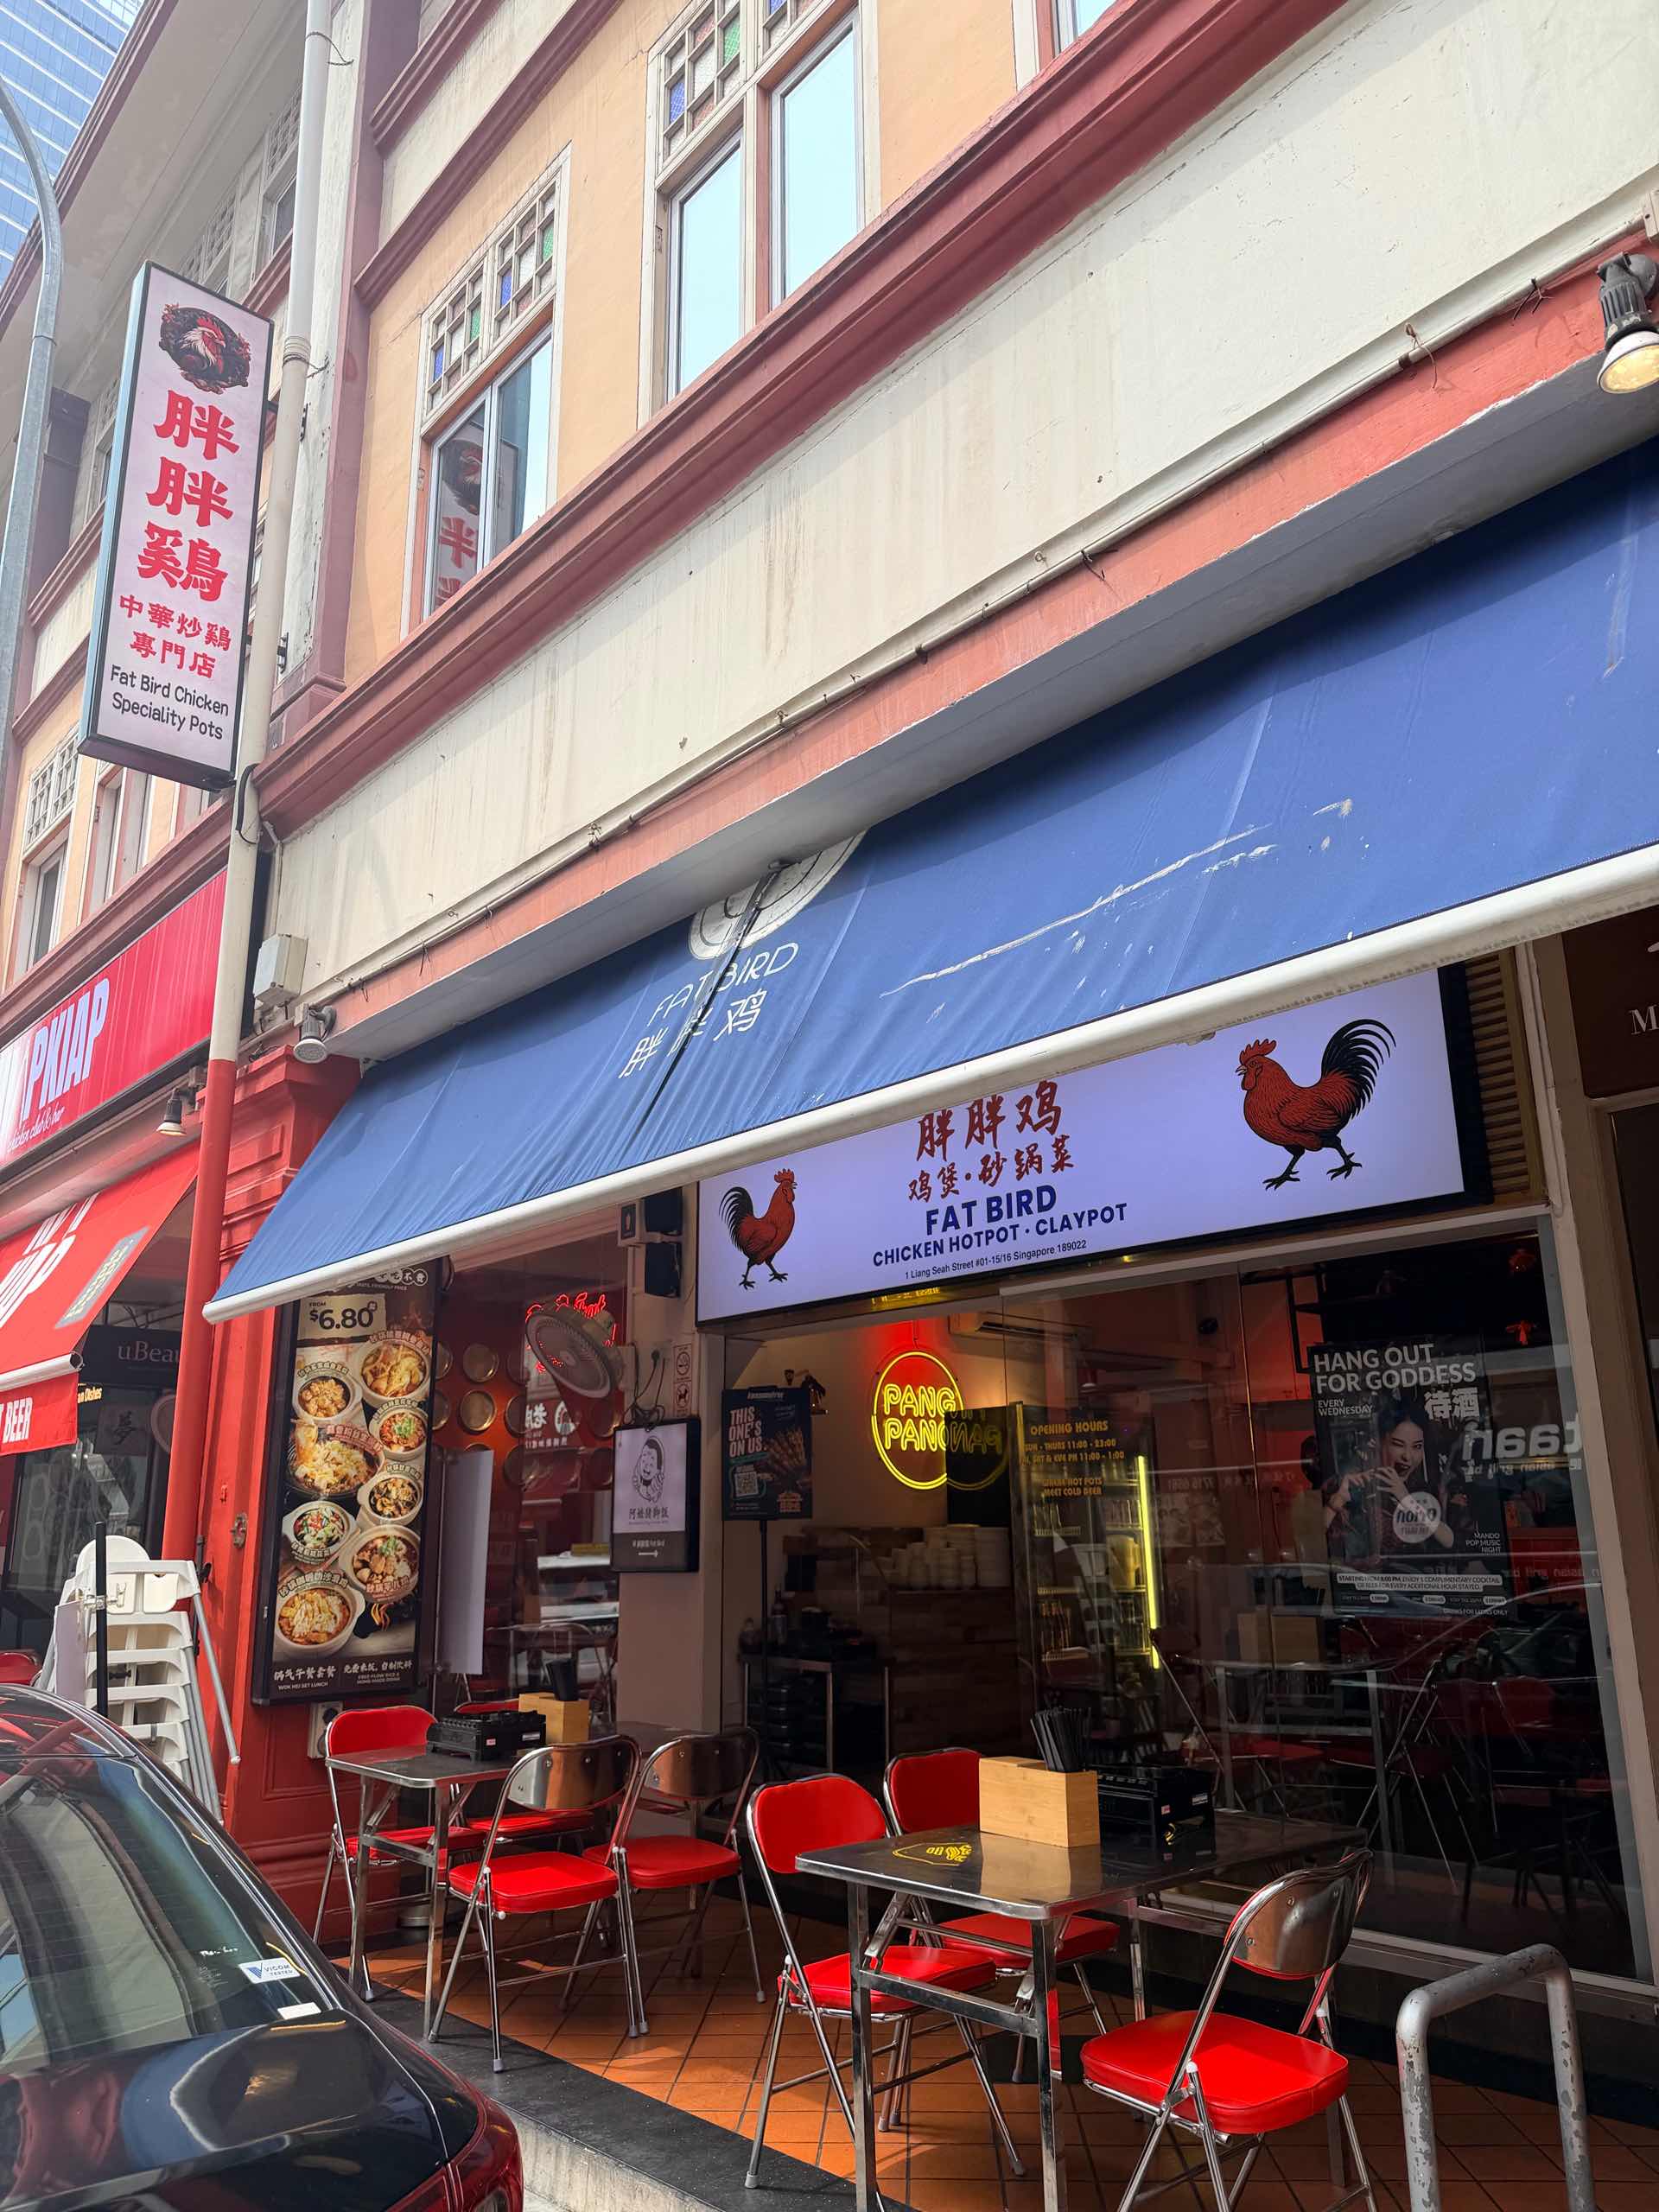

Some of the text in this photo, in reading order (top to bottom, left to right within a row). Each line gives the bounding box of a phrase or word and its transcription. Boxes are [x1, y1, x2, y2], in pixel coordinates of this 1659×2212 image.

[130, 630, 216, 677] 專門店
[111, 664, 229, 717] Fat Bird Chicken
[112, 692, 224, 740] Speciality Pots
[648, 942, 799, 1027] FAT BIRD
[917, 1079, 1063, 1162] 胖胖鸡
[925, 1184, 1057, 1236] FAT BIRD
[873, 1239, 944, 1267] CHICKEN
[949, 1224, 1020, 1252] HOTPOT
[1036, 1203, 1128, 1236] CLAYPOT
[910, 1266, 931, 1281] Liang
[931, 1263, 950, 1275] Seah
[951, 1259, 974, 1272] Street
[976, 1251, 1012, 1268] #01-15/16
[1013, 1244, 1055, 1263] Singapore
[1057, 1239, 1087, 1254] 189022
[1314, 1343, 1434, 1373] HANG OUT
[1316, 1362, 1477, 1395] FOR GODDESS
[883, 1382, 956, 1418] PANG
[1318, 1398, 1344, 1408] EVERY
[1319, 1405, 1373, 1417] WEDNESDAY
[3, 1396, 34, 1444] BEER
[729, 1405, 755, 1426] THIS
[1030, 1420, 1109, 1436] OPENING HOURS
[728, 1421, 762, 1441] ONE'S
[729, 1440, 747, 1459] ON
[1044, 1441, 1065, 1452] THURS
[1067, 1440, 1088, 1449] 11:00
[1095, 1439, 1116, 1448] 23:00
[1079, 1452, 1101, 1462] 11:00
[1108, 1451, 1125, 1459] 1:00
[1064, 1487, 1082, 1496] COLD
[1068, 1478, 1083, 1486] HOT
[1481, 1539, 1502, 1548] MUSIC
[1481, 1546, 1502, 1554] NIGHT
